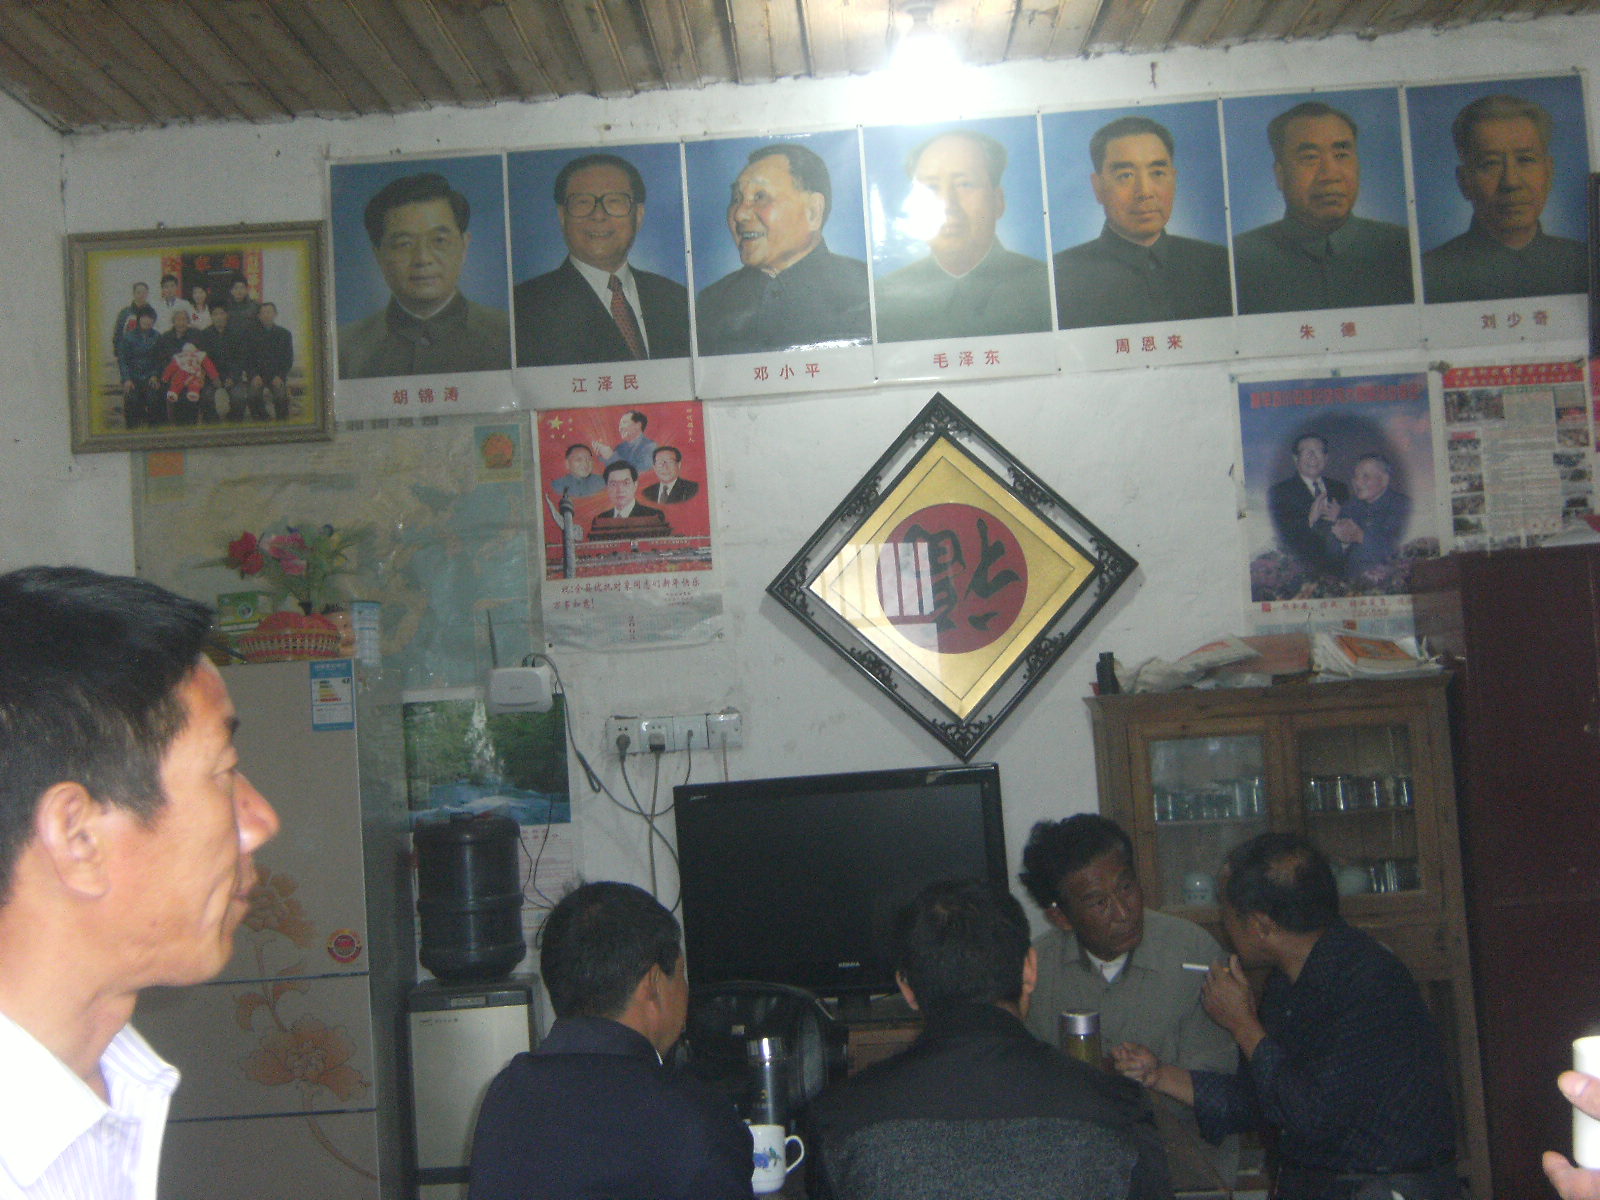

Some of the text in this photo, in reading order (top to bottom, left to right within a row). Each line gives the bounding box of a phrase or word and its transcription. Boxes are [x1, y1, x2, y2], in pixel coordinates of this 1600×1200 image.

[1481, 310, 1548, 329] 刘少奇
[1300, 322, 1357, 339] 朱德
[1116, 334, 1183, 353] 周恩来
[933, 350, 1000, 368] 毛泽东
[754, 363, 820, 381] 邓小平
[572, 374, 639, 393] 江泽民
[392, 386, 459, 405] 胡锦涛
